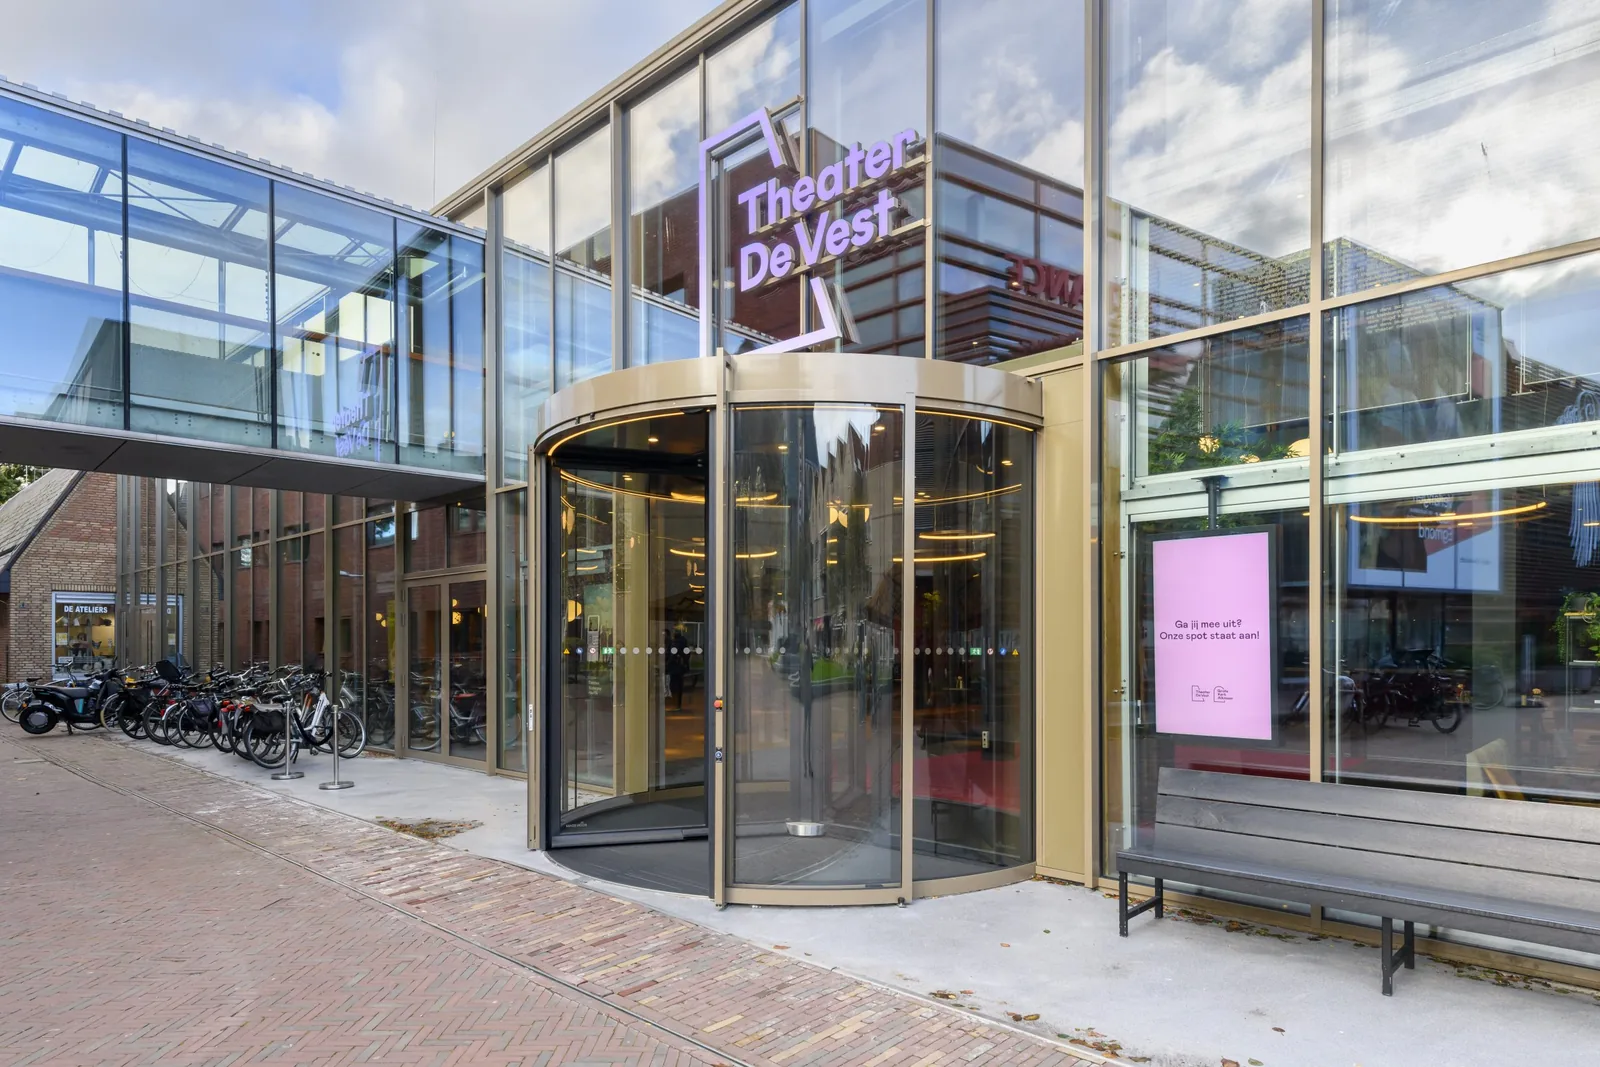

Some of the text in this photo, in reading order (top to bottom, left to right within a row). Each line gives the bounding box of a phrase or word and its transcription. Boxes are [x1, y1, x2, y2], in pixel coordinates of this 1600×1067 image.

[737, 128, 917, 235] Theater
[63, 605, 108, 614] DE ATELIERS
[1174, 619, 1189, 629] Ga
[1191, 620, 1199, 630] jij
[1223, 618, 1242, 628] uit?
[1159, 631, 1260, 642] Onze spot staat aan!
